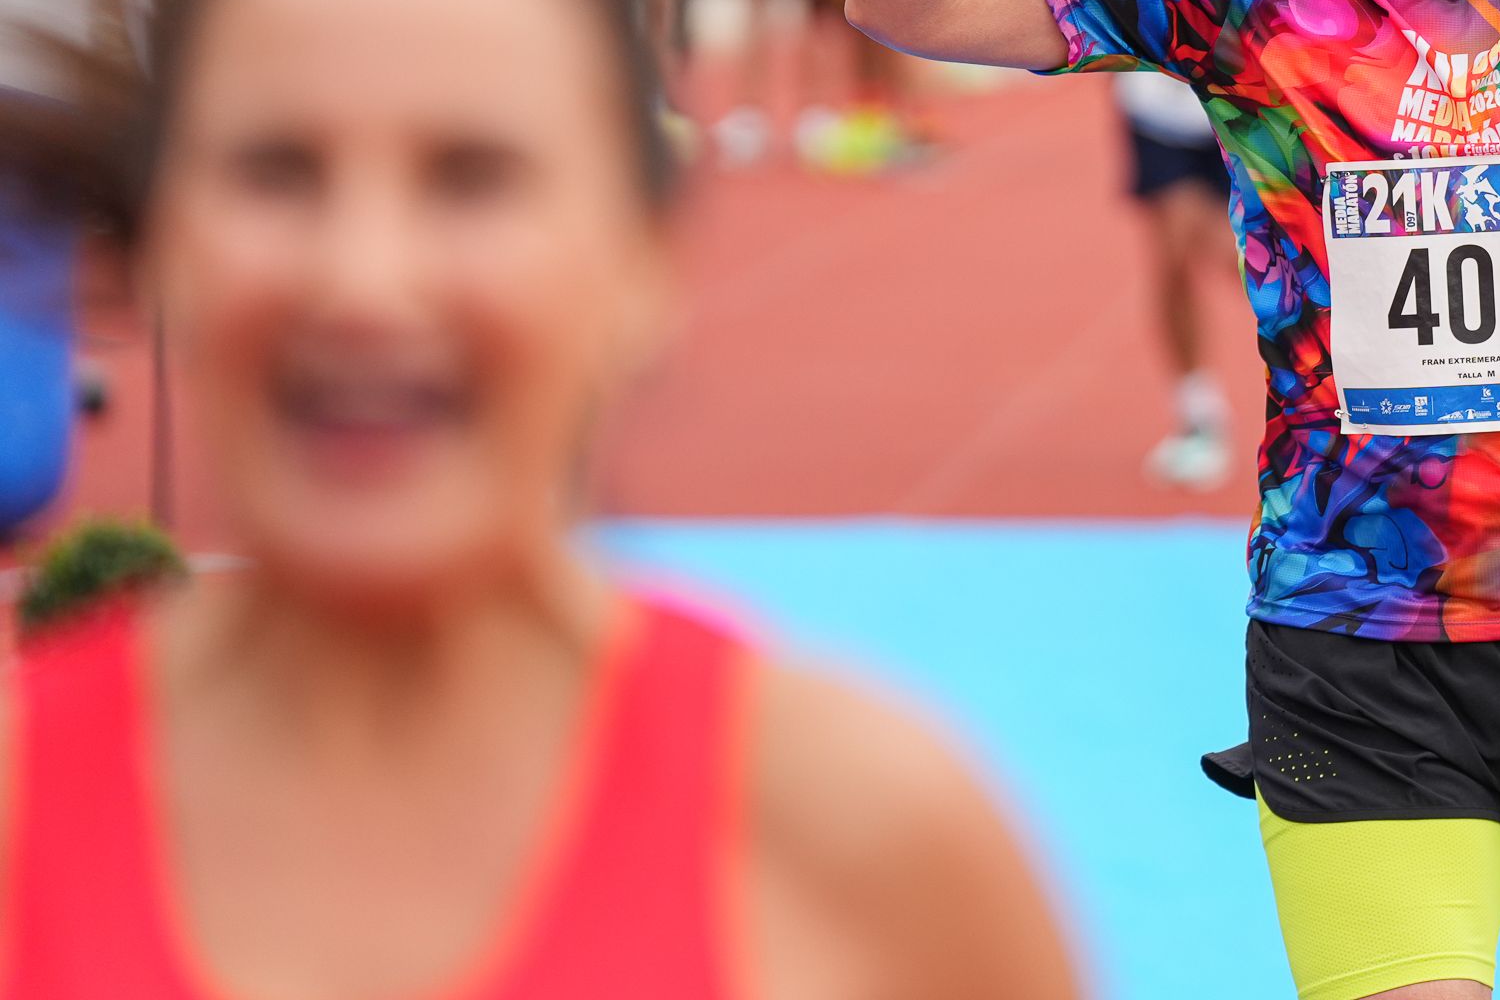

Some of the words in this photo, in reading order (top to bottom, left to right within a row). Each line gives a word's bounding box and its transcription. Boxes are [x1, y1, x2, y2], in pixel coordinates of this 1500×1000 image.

[1397, 86, 1472, 132] MEDIA
[1334, 196, 1348, 235] MEDIA
[1343, 174, 1361, 235] MARATÓN
[1362, 170, 1455, 234] 21K
[1421, 358, 1446, 366] FRAN
[1457, 372, 1483, 380] TALLA
[1487, 370, 1496, 379] M
